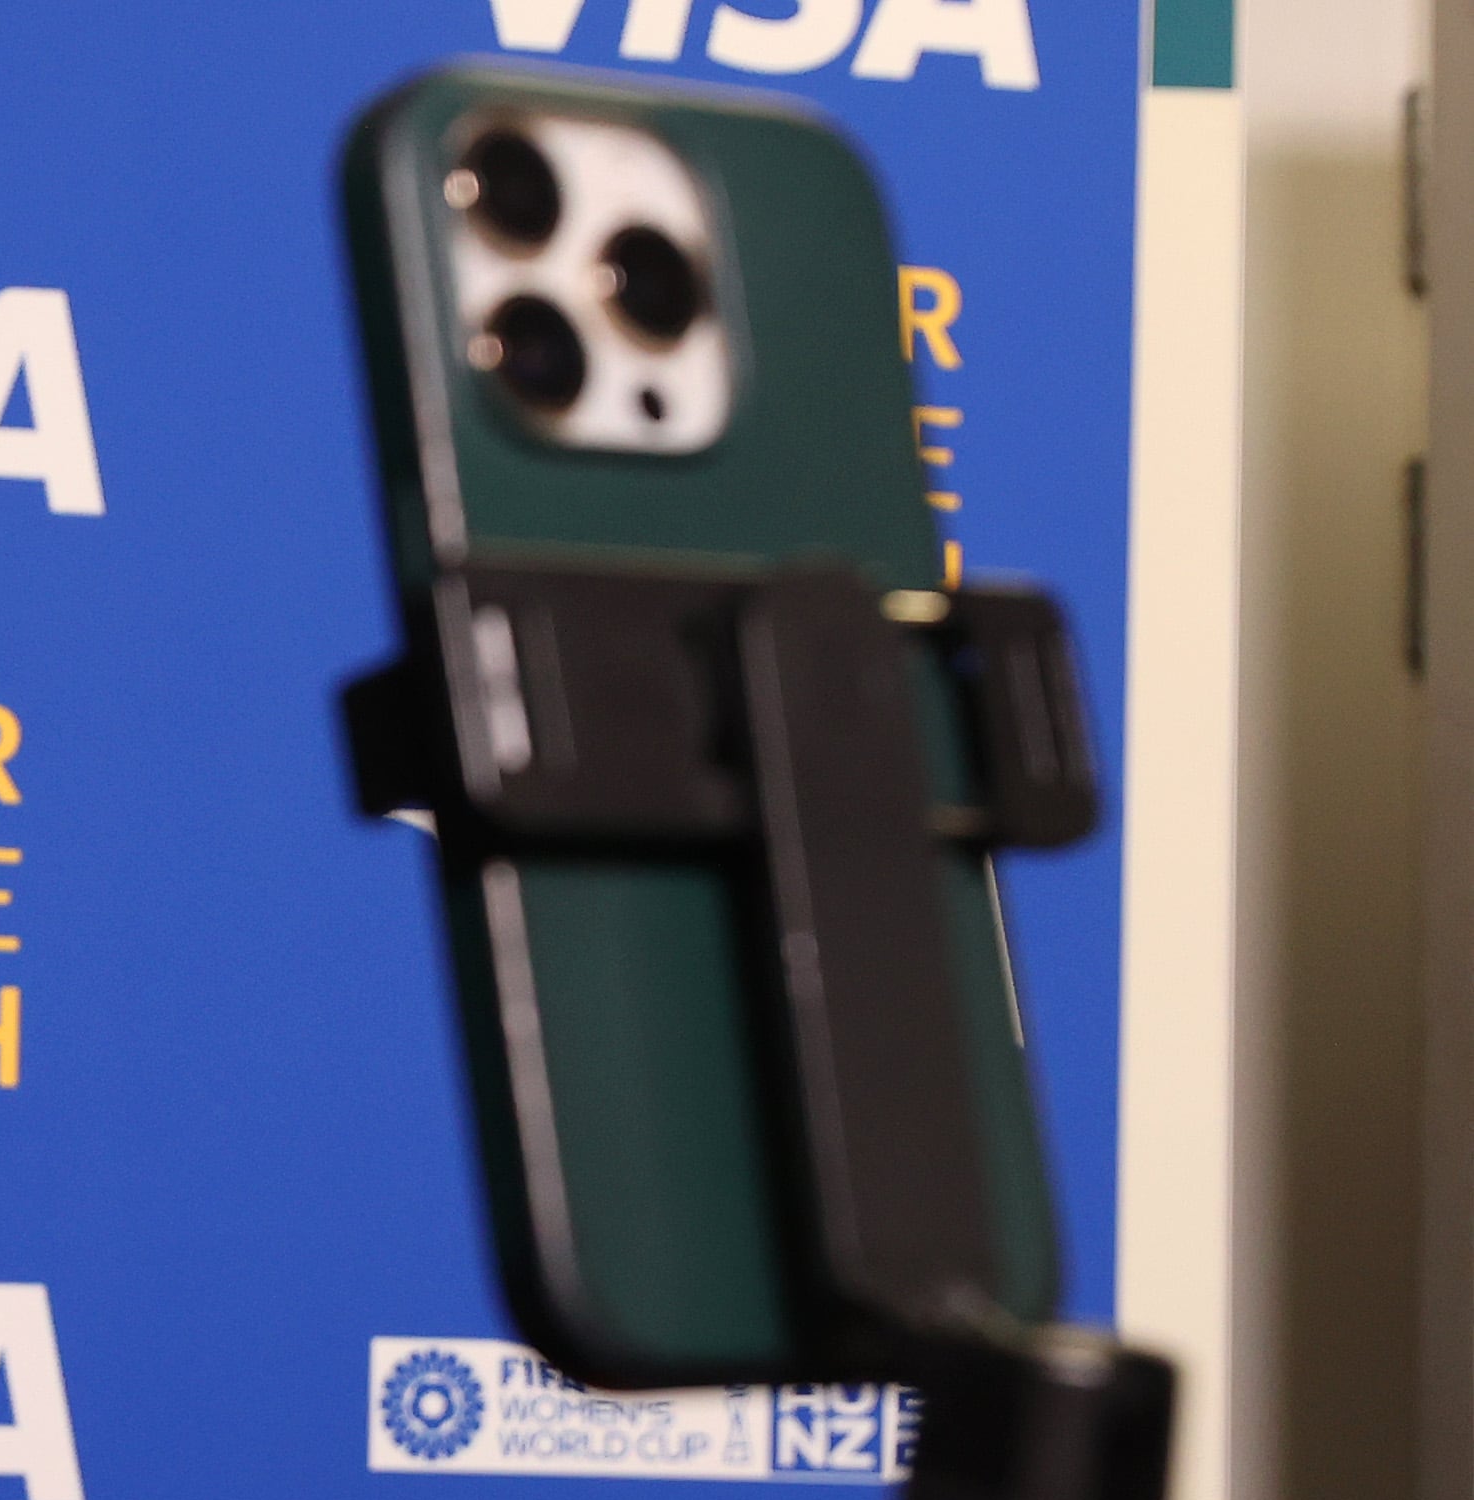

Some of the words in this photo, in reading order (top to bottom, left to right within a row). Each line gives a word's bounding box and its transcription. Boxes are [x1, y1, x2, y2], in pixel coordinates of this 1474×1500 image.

[497, 1429, 627, 1460] WORLD
[637, 1432, 709, 1462] CUP
[777, 1414, 880, 1469] NZ
